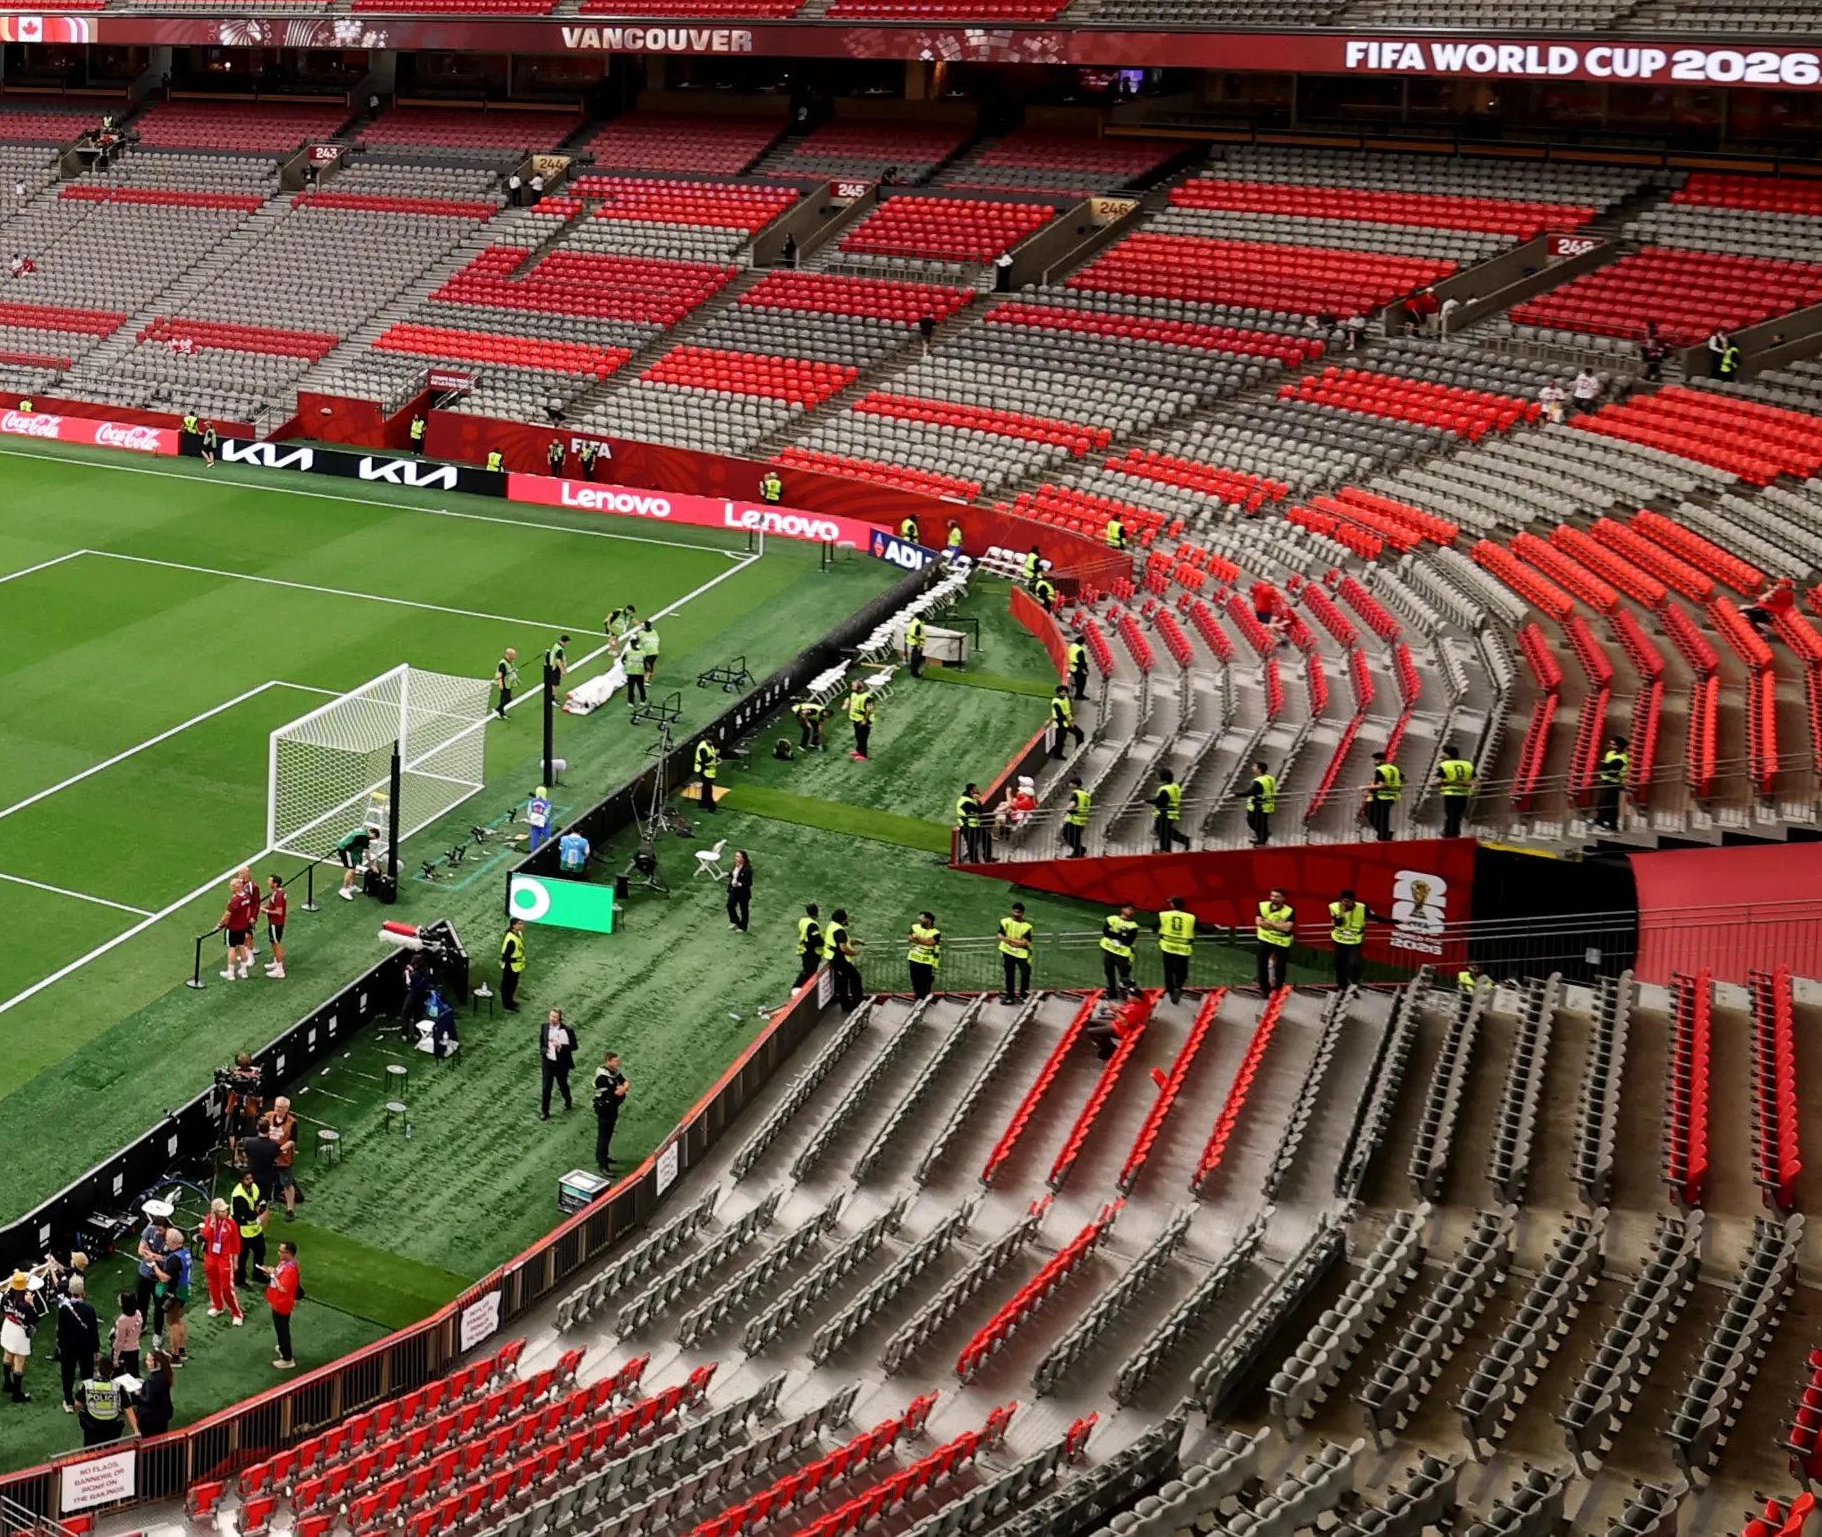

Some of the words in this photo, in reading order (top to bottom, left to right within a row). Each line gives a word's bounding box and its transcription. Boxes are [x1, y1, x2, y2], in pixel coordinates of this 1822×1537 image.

[561, 27, 753, 52] VANCOUVER
[1345, 41, 1430, 69] FIFA
[1431, 44, 1579, 77] WORLD
[1585, 47, 1666, 78] CUP
[1671, 49, 1820, 85] 2026
[316, 147, 338, 159] 243
[540, 158, 563, 170] 244
[839, 184, 865, 197] 245
[1100, 202, 1128, 214] 246
[561, 482, 670, 517] Lenovo
[725, 502, 839, 541] Lenovo
[885, 541, 923, 570] ADI
[88, 1392, 118, 1402] POLICE
[79, 1468, 91, 1476] NO
[113, 1468, 125, 1478] OR
[81, 1482, 105, 1494] SIGNS
[105, 1479, 118, 1488] ON
[73, 1495, 88, 1504] THE
[89, 1486, 125, 1502] RAILINGS
